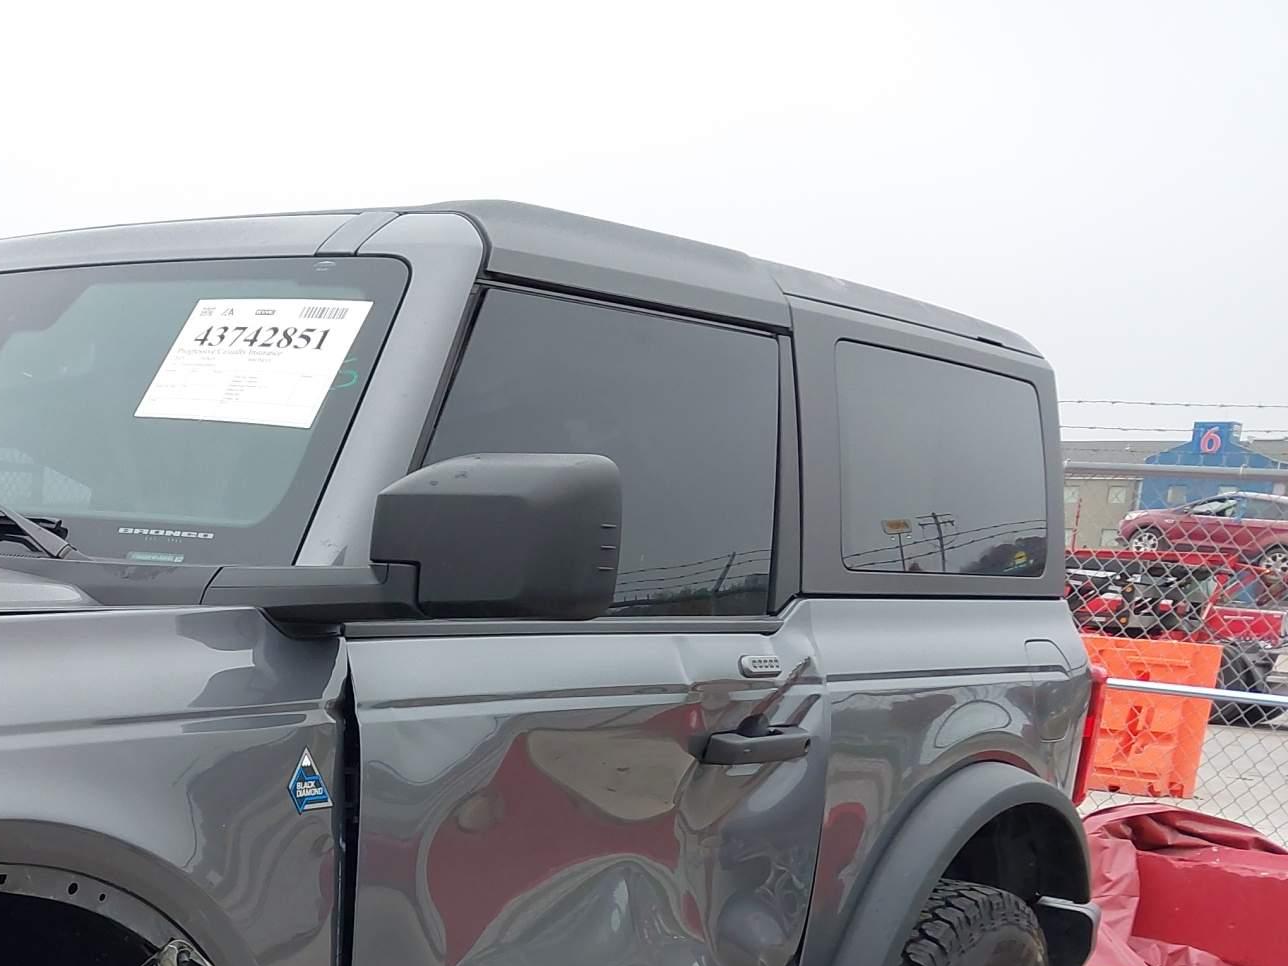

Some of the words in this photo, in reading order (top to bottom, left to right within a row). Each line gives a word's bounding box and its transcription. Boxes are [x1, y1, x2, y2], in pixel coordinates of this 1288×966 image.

[194, 326, 331, 350] 43742851
[1200, 426, 1221, 453] 6
[118, 527, 214, 539] BRONCO
[296, 781, 316, 790] BLACK
[296, 787, 324, 798] DIAMOND
